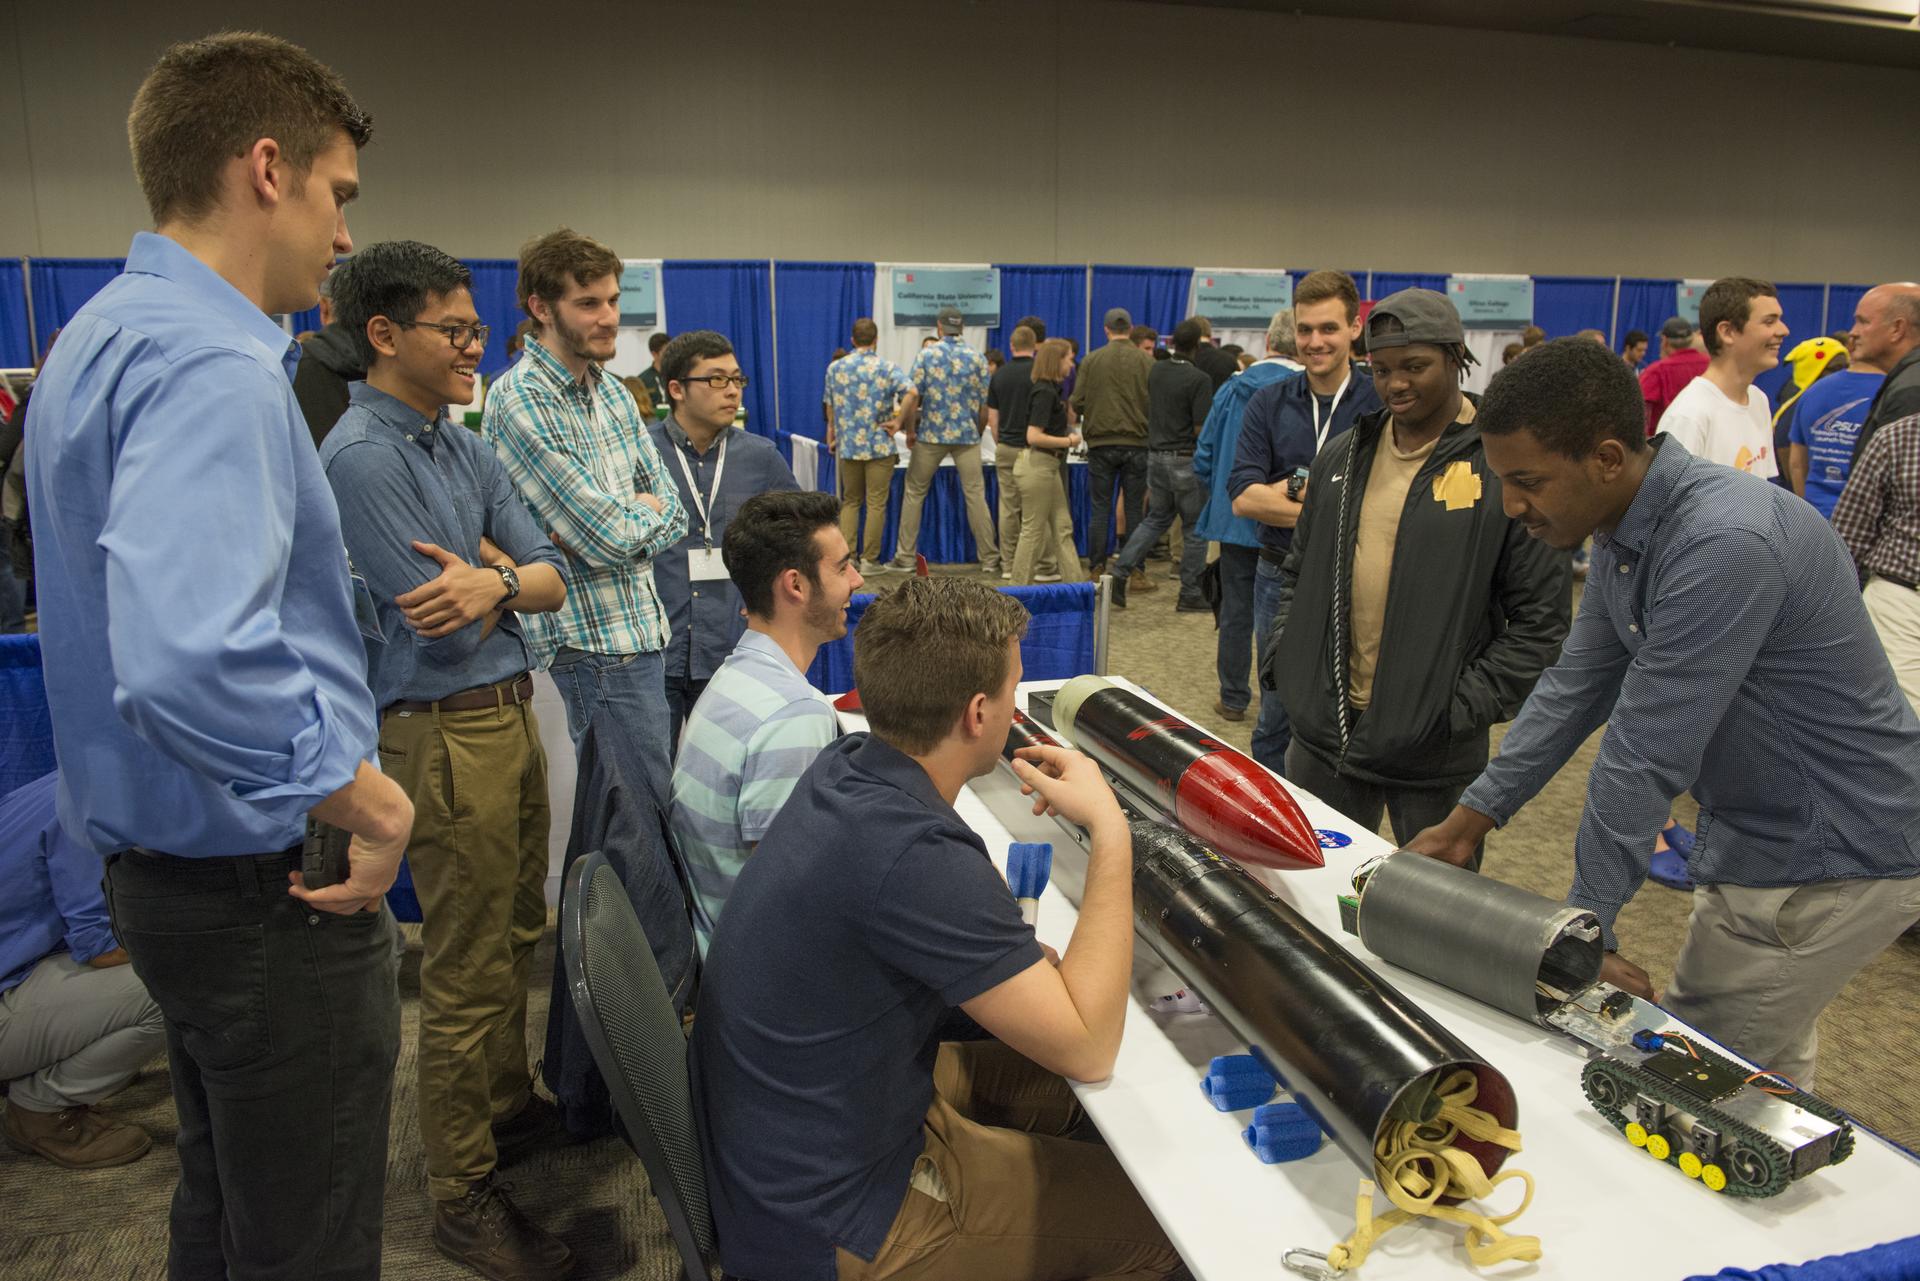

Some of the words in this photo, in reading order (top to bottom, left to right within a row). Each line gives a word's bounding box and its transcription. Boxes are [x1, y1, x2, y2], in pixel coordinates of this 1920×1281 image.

[898, 292, 935, 300] California
[937, 292, 956, 300] State
[1198, 295, 1226, 303] Carnegie
[1253, 296, 1286, 304] University
